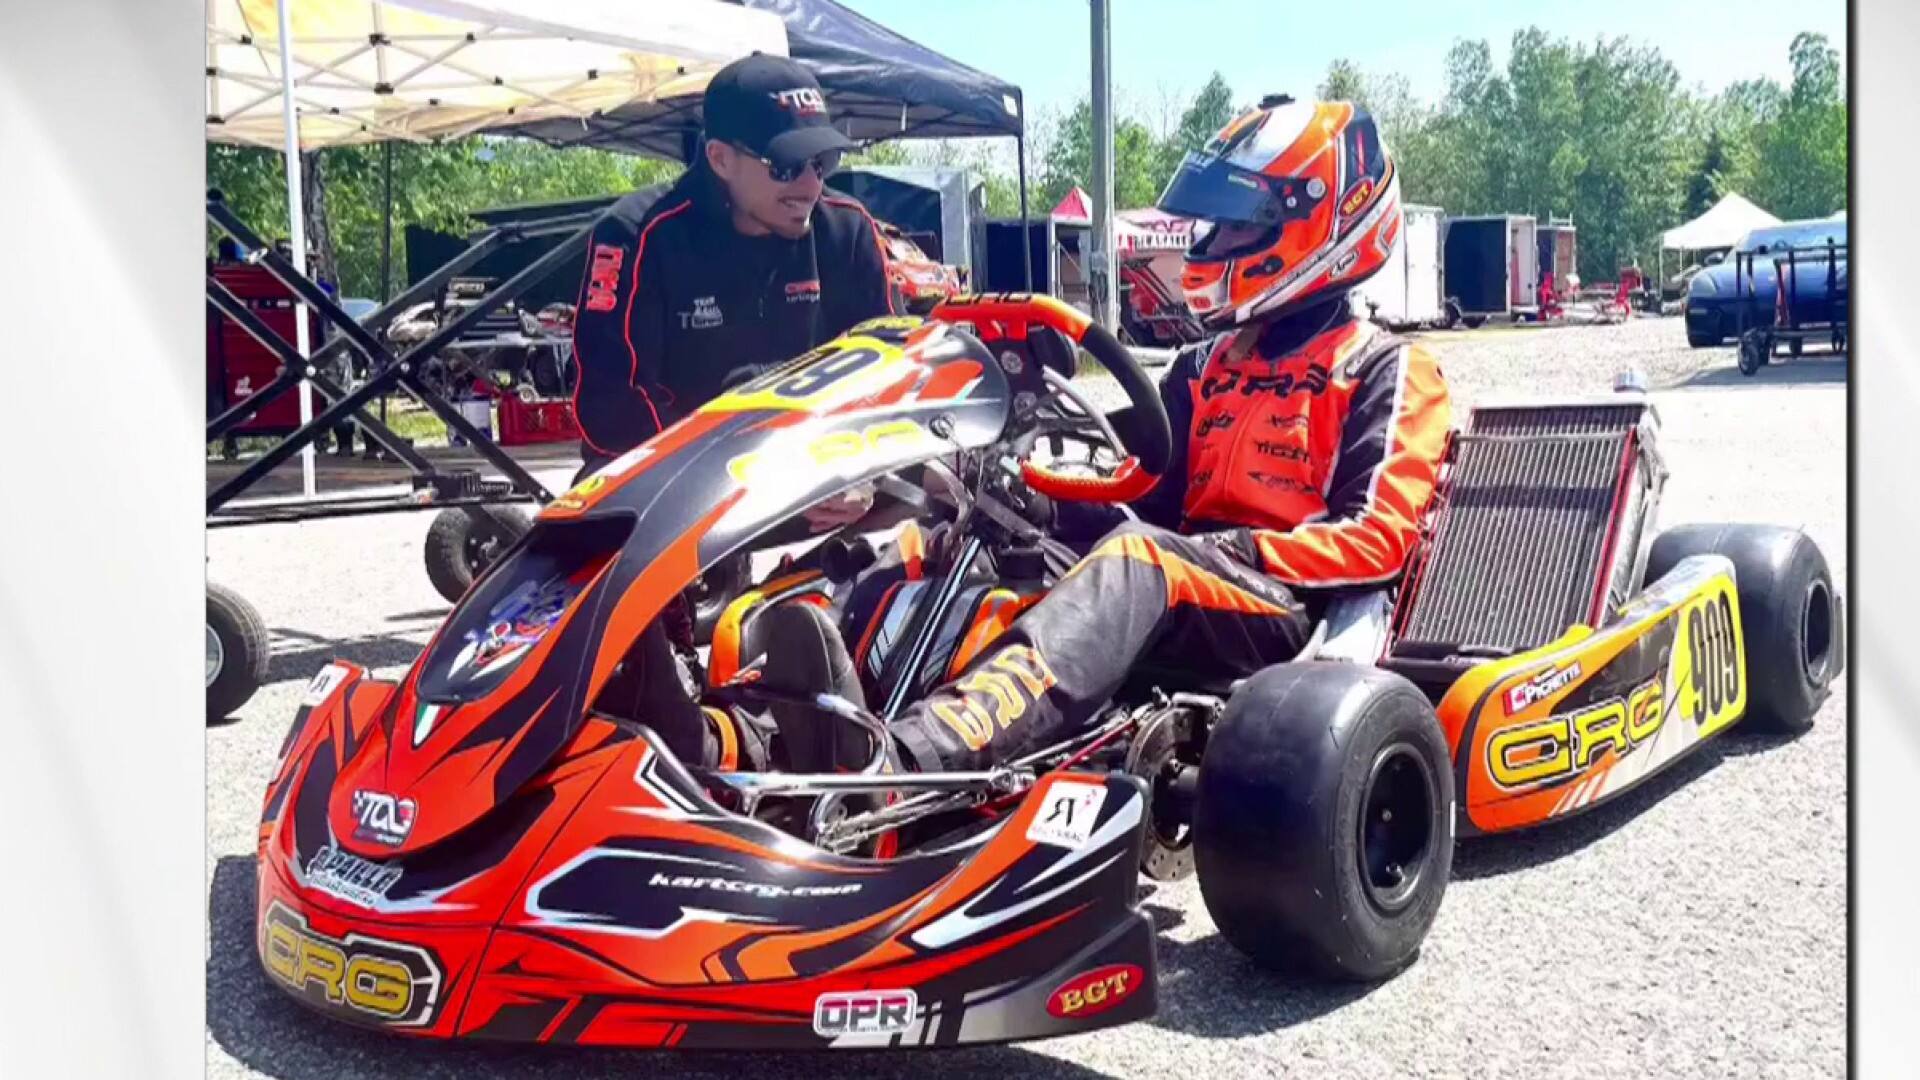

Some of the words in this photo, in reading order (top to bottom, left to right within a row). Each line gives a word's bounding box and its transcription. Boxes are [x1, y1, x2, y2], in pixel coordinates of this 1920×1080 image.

[1689, 589, 1741, 727] 909
[1486, 681, 1665, 790] CRG
[266, 919, 415, 1019] CRG
[820, 996, 909, 1030] OPR
[1061, 971, 1130, 1013] BGT
